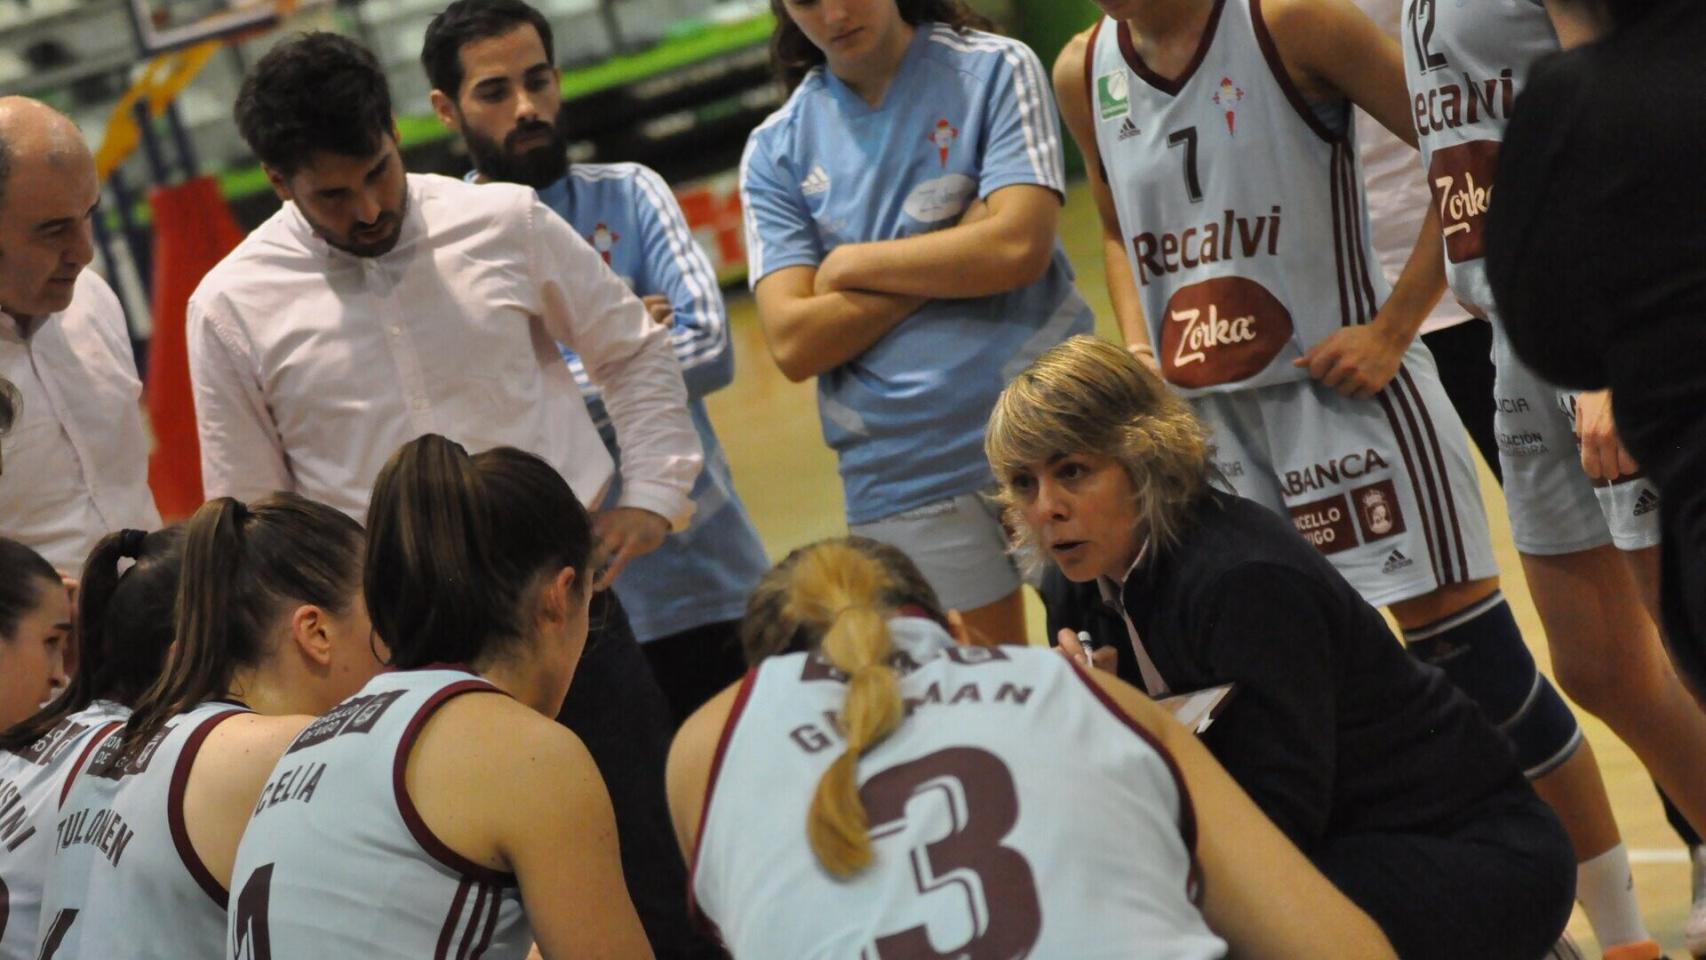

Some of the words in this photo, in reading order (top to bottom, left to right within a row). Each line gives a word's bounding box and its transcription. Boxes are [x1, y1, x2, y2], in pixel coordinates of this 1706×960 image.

[1167, 126, 1204, 204] 7
[1435, 171, 1495, 237] Zork
[1132, 205, 1282, 286] Recalvi
[1171, 304, 1256, 368] Zorka
[789, 682, 1036, 754] GMAN
[254, 761, 327, 818] CELIA
[55, 807, 134, 868] TULONEN
[859, 747, 1043, 960] 3
